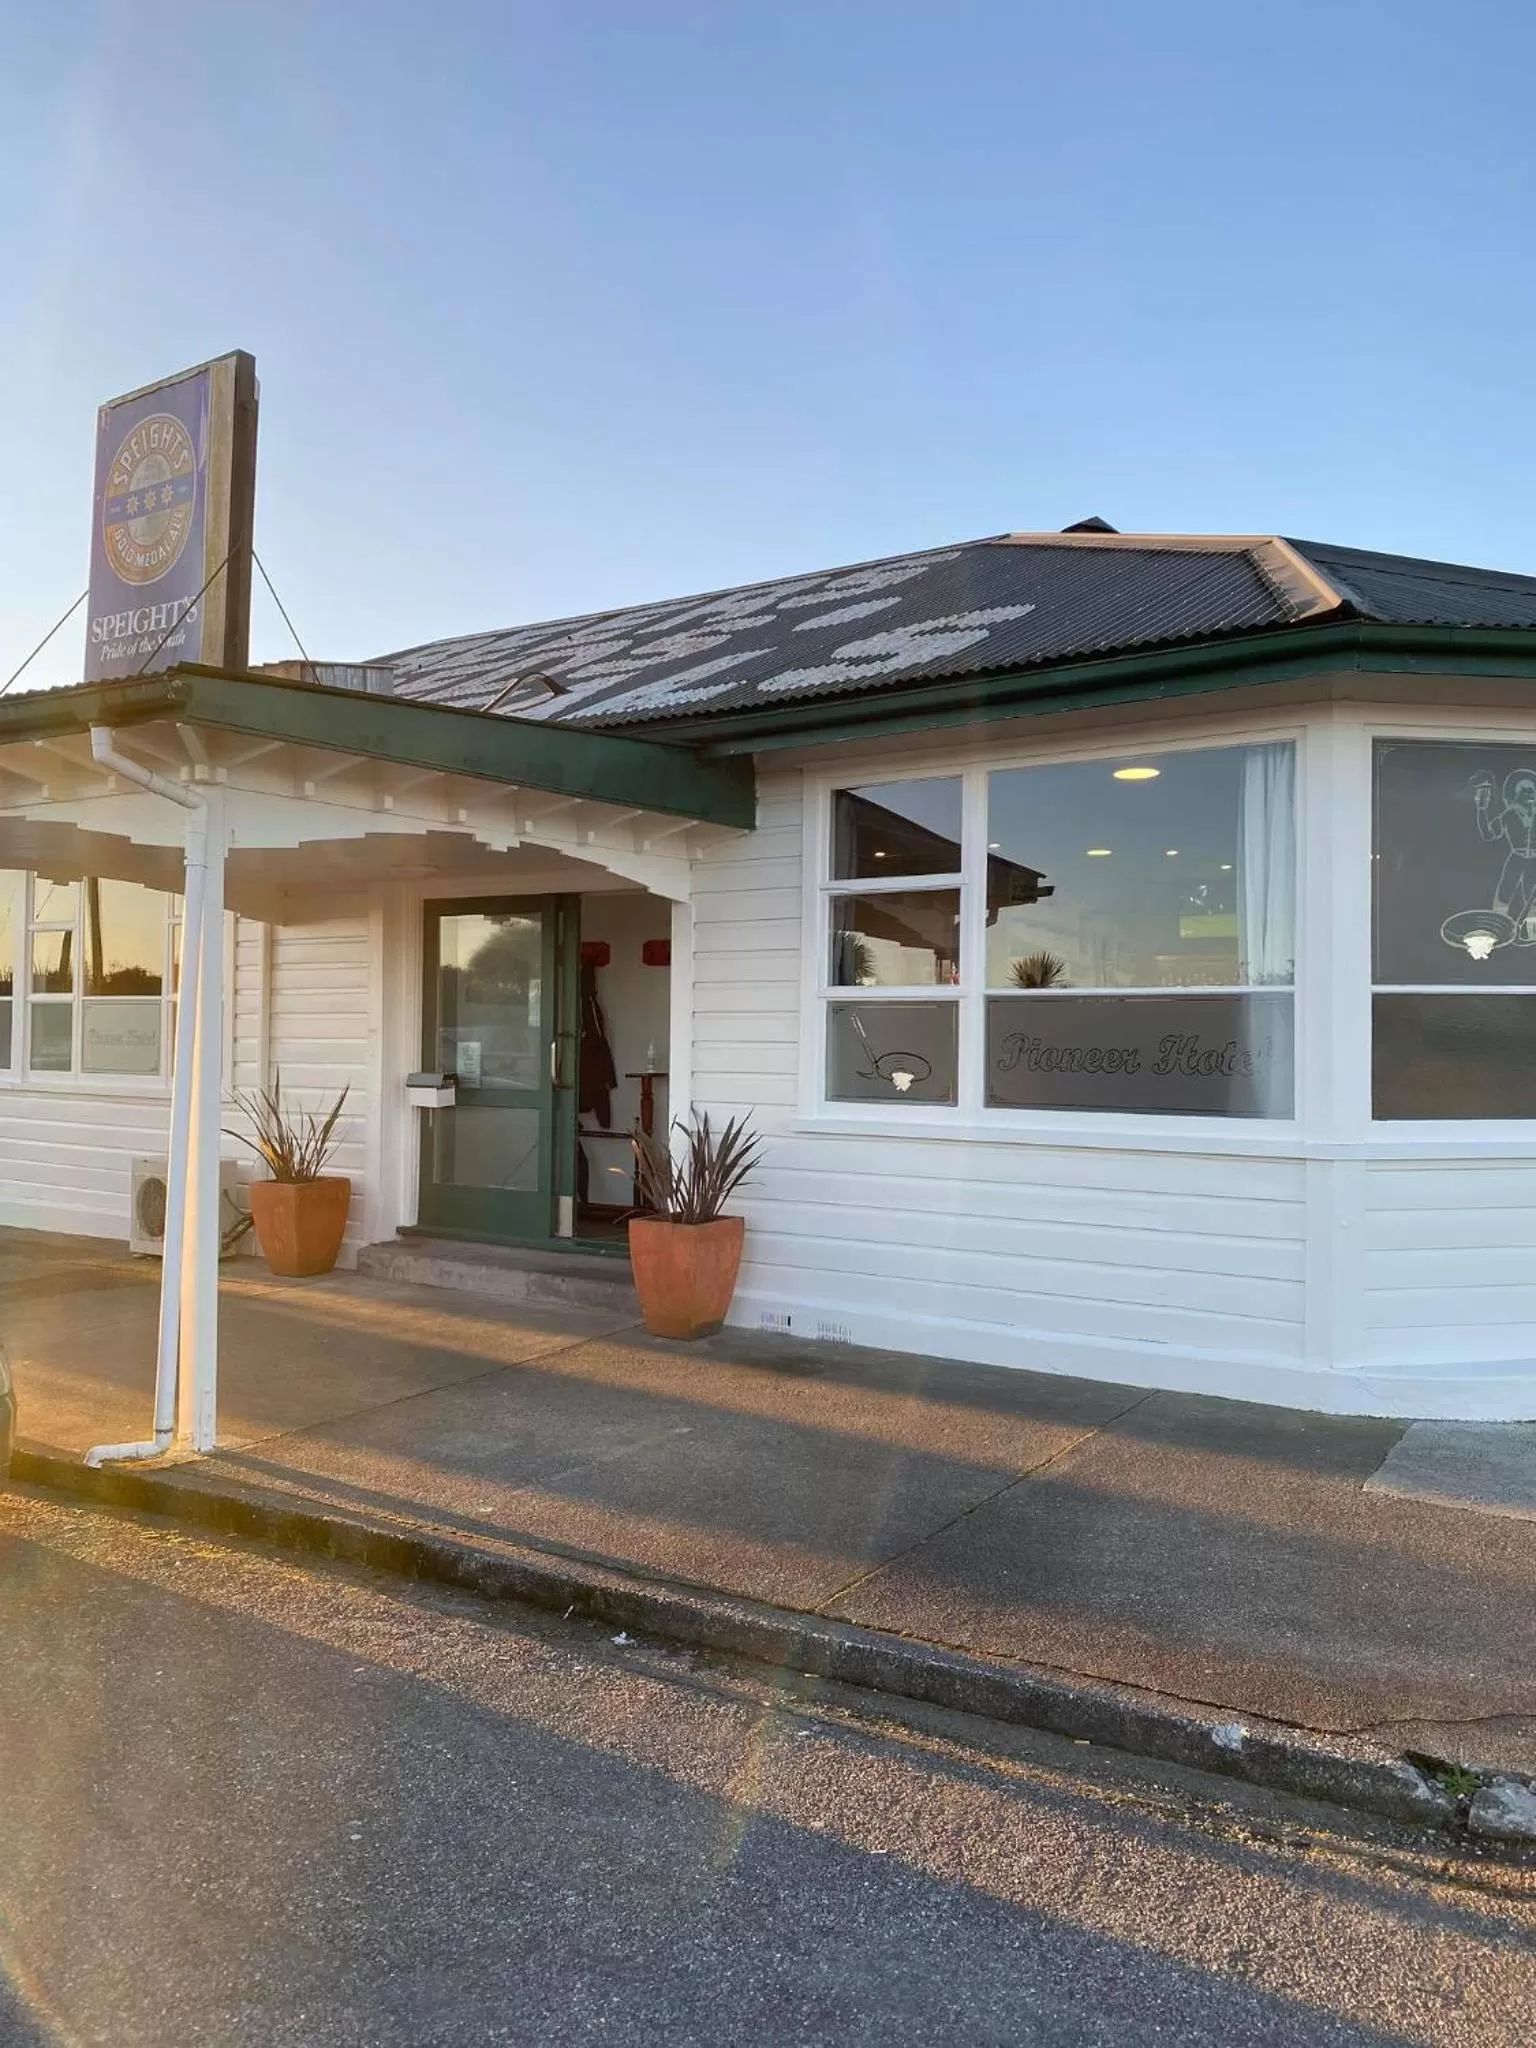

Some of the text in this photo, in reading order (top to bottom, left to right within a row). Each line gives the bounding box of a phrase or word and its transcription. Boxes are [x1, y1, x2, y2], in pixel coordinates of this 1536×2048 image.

[135, 540, 171, 568] MEDAL
[91, 596, 198, 644] SPEIGHT'S
[100, 641, 127, 662] Pride
[127, 639, 140, 658] of
[139, 635, 156, 654] the
[999, 1032, 1141, 1074] Pioneer
